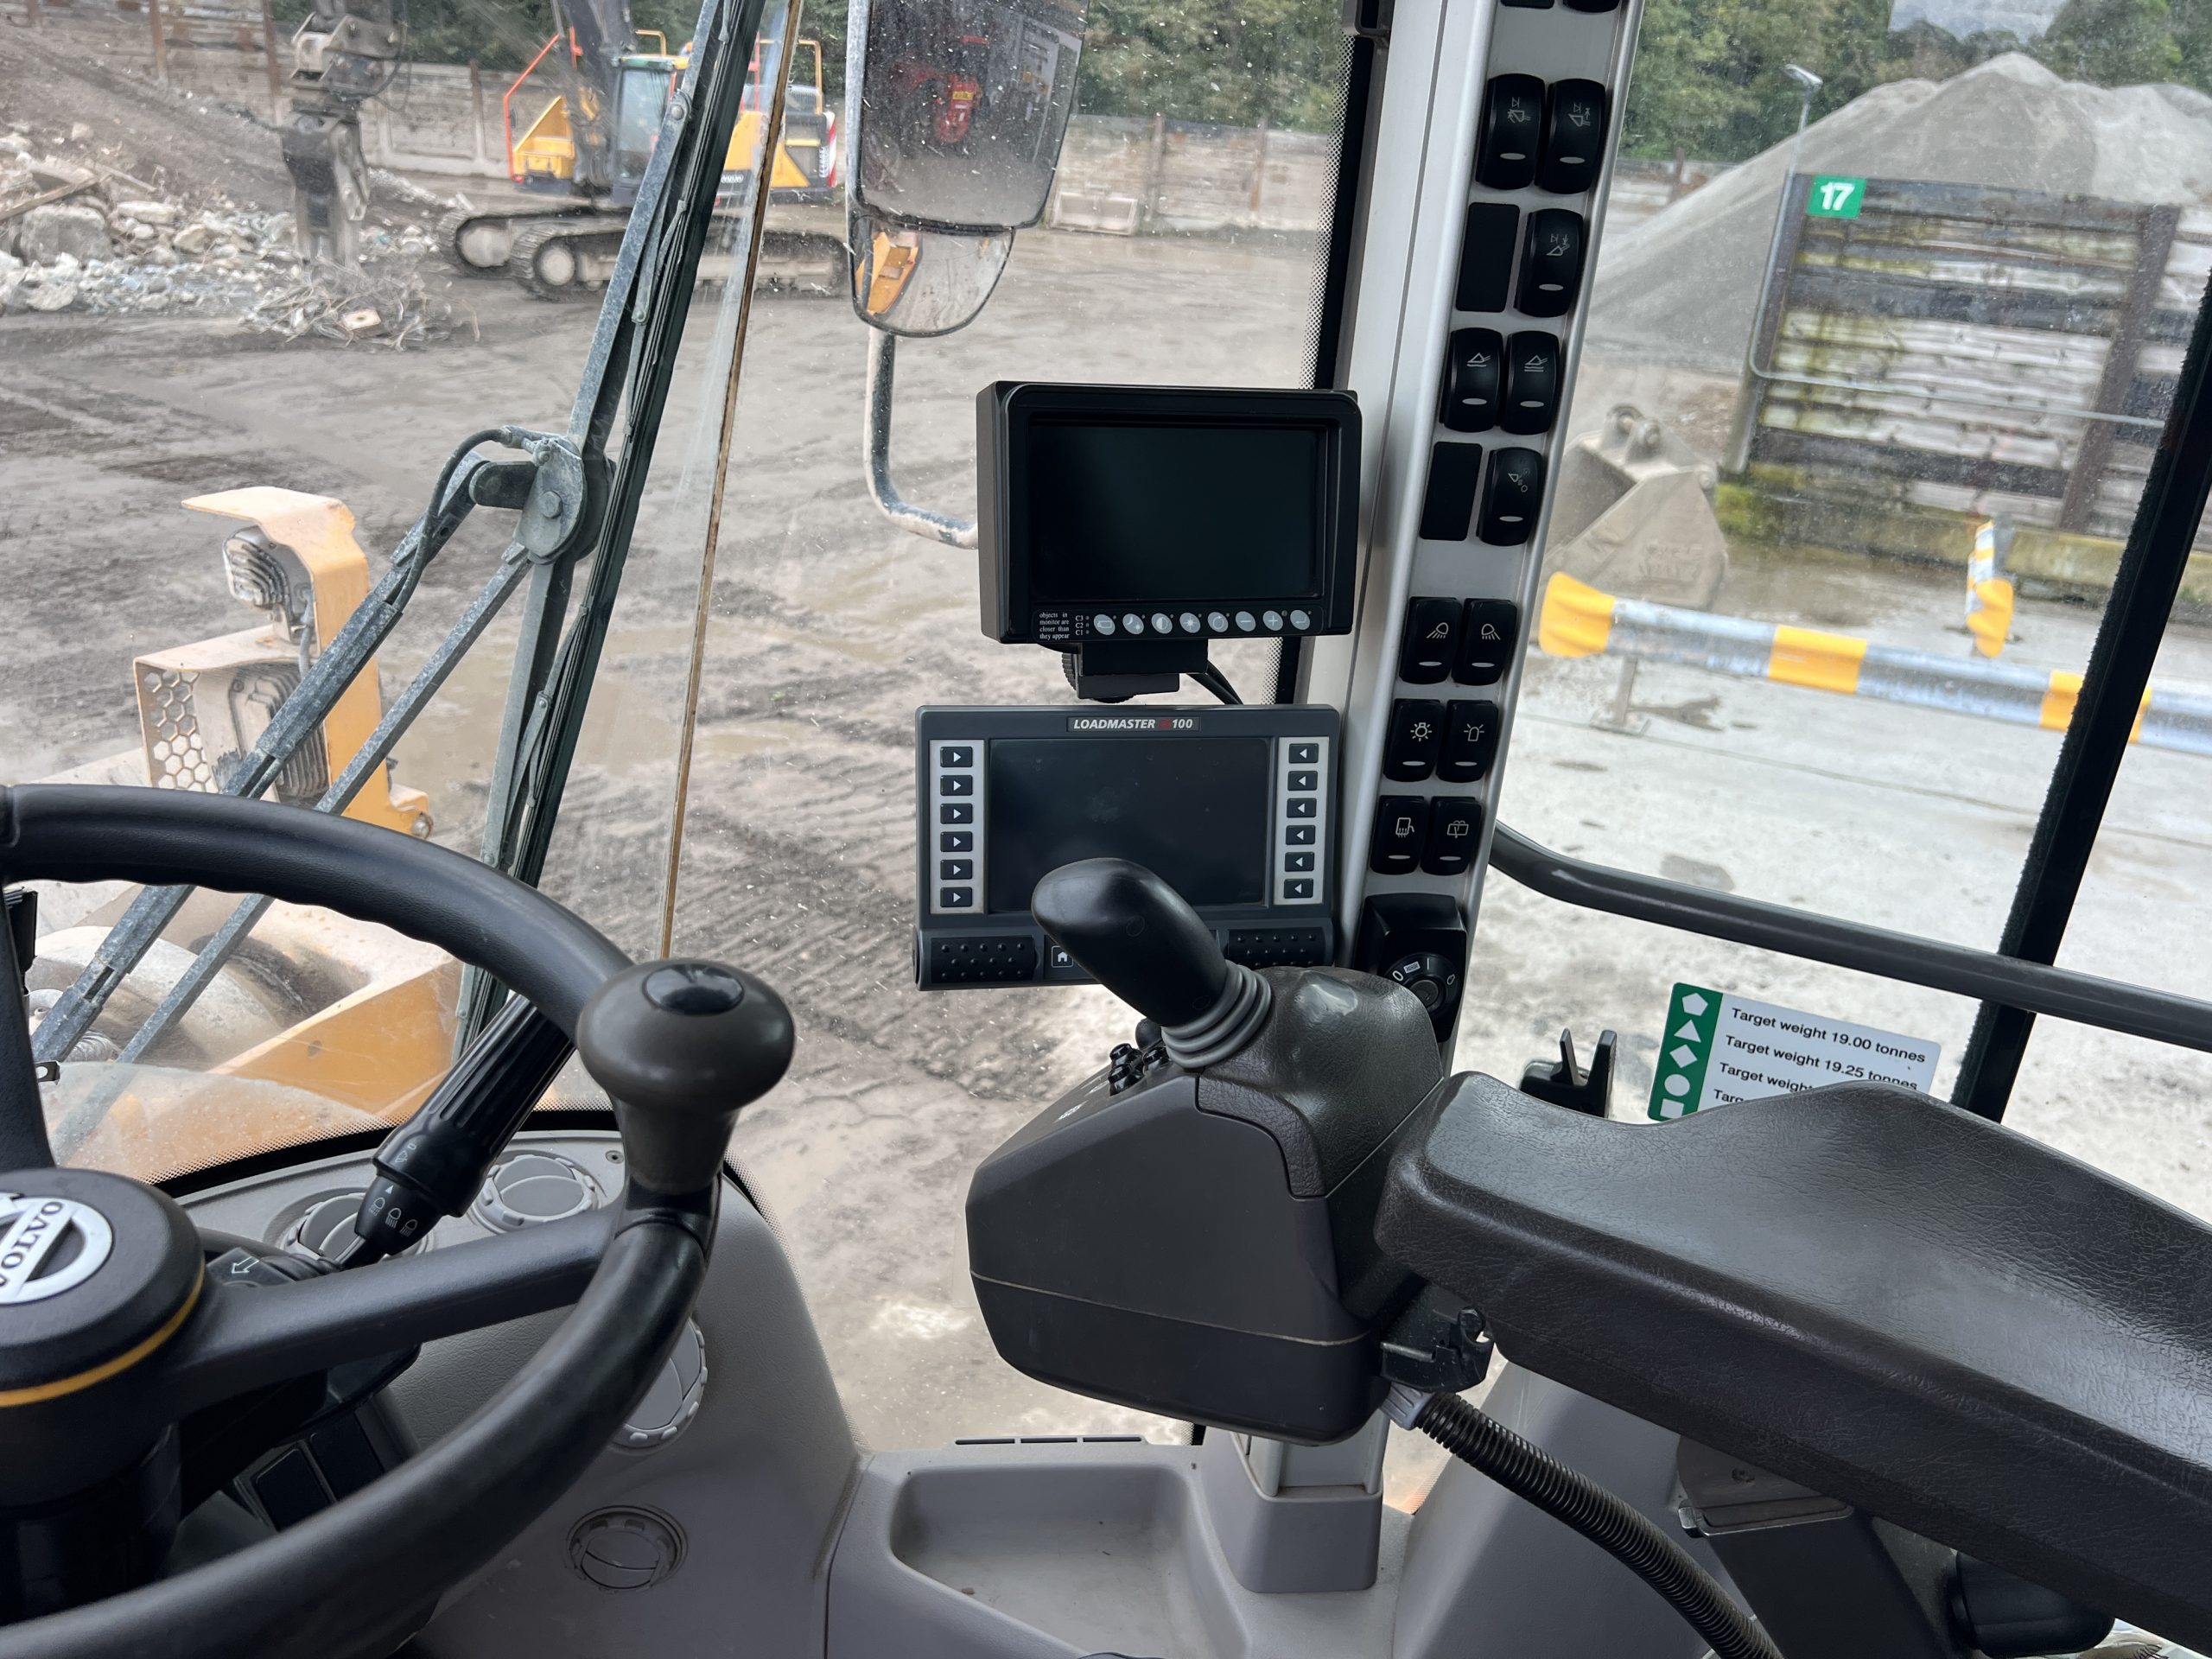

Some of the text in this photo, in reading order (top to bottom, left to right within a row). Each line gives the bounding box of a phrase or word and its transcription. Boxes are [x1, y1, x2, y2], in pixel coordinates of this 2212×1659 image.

[1820, 181, 1855, 211] 17
[1039, 632, 1051, 641] they
[1073, 719, 1156, 729] LOADMASTER
[1732, 1007, 1926, 1064] Target weight 19.00 tonnes
[1726, 1034, 1770, 1054] Target
[1773, 1048, 1820, 1068] weight
[1825, 1059, 1865, 1078] 19.25
[1719, 1061, 1813, 1093] Target weigh
